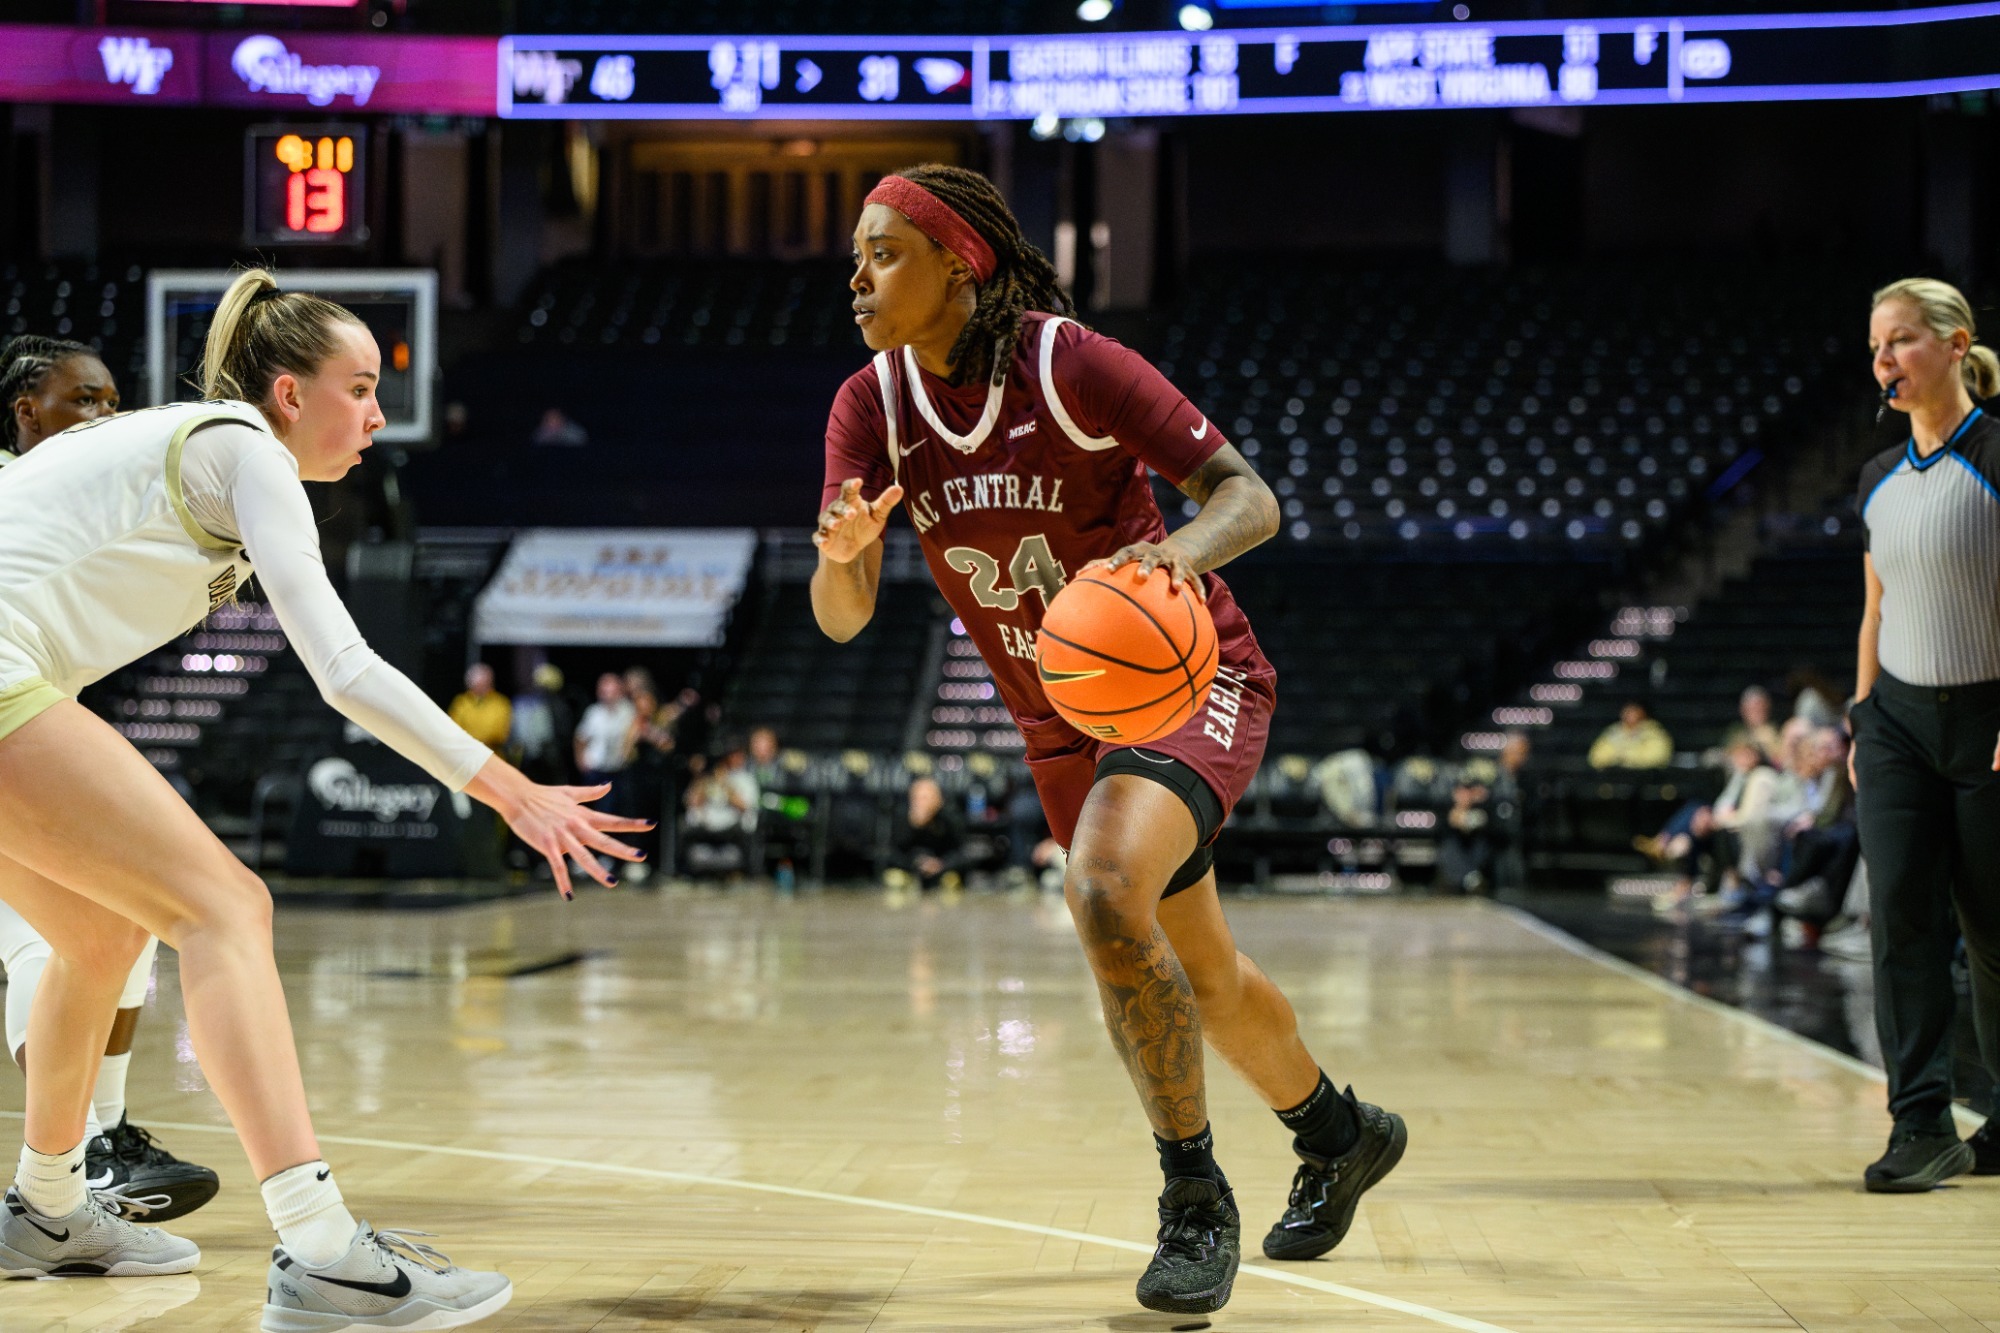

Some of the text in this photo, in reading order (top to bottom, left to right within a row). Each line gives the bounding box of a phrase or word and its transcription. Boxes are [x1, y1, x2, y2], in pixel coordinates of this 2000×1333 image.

[276, 134, 353, 172] 9:11
[287, 168, 343, 232] 13
[1008, 420, 1036, 440] MEAC
[943, 473, 1064, 514] CENTRAL
[944, 533, 1067, 612] 24
[996, 623, 1041, 662] EAG
